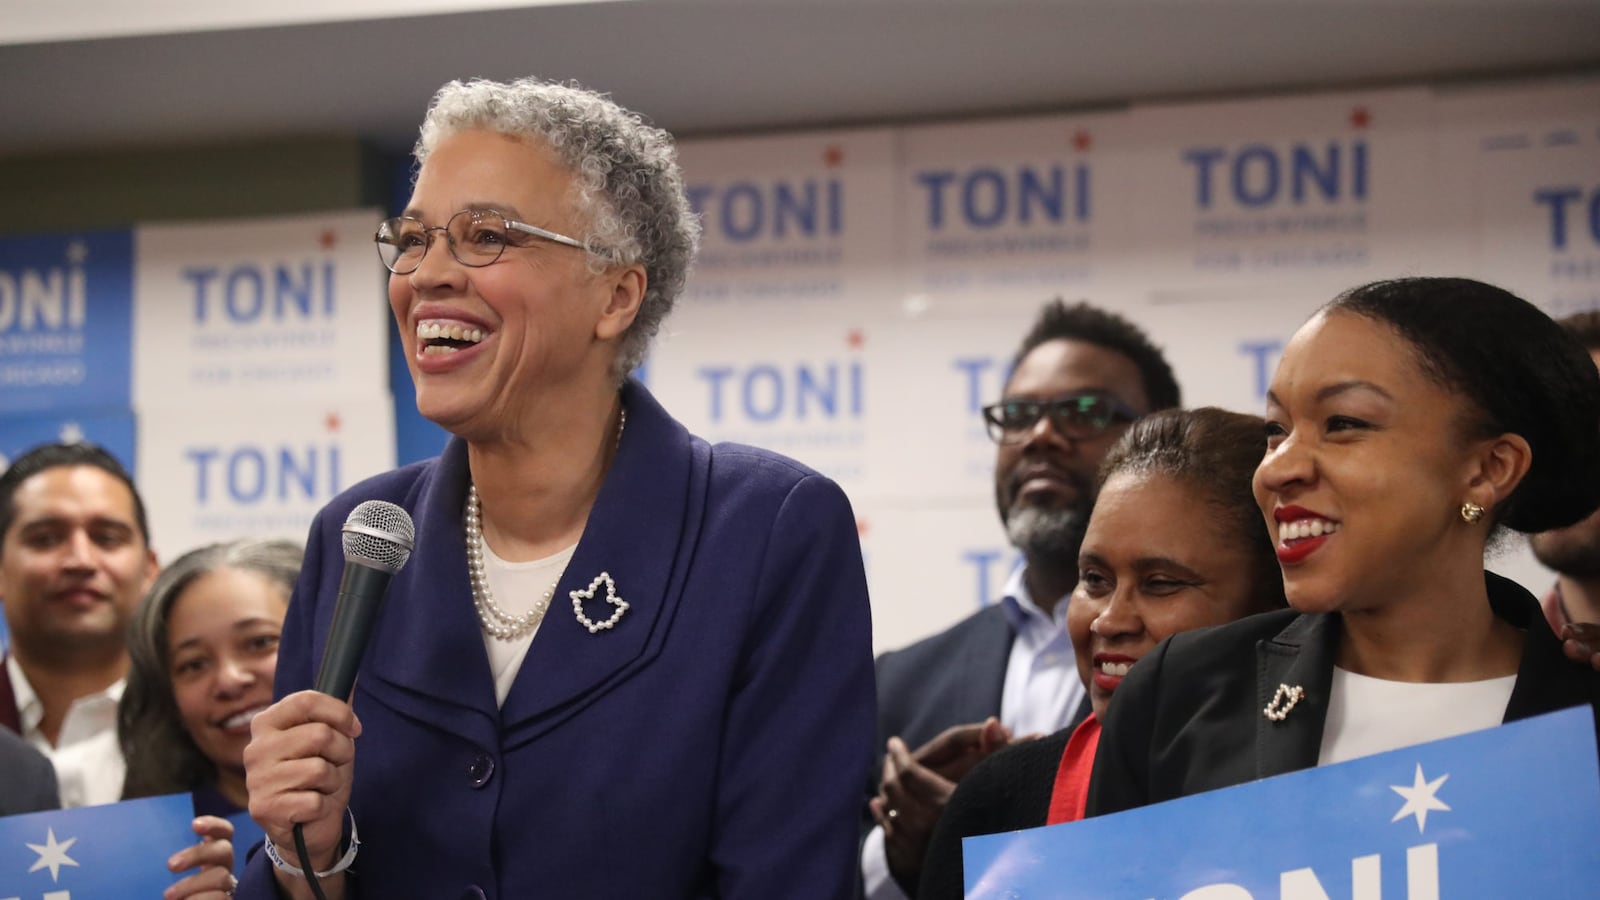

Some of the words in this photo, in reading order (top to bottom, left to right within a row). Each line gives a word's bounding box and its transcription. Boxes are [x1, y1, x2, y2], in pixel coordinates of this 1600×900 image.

[914, 164, 1091, 230] TONI
[1183, 139, 1370, 208] TONI
[183, 261, 338, 326] TONI
[698, 361, 864, 422] TONI
[187, 446, 341, 506] TONI
